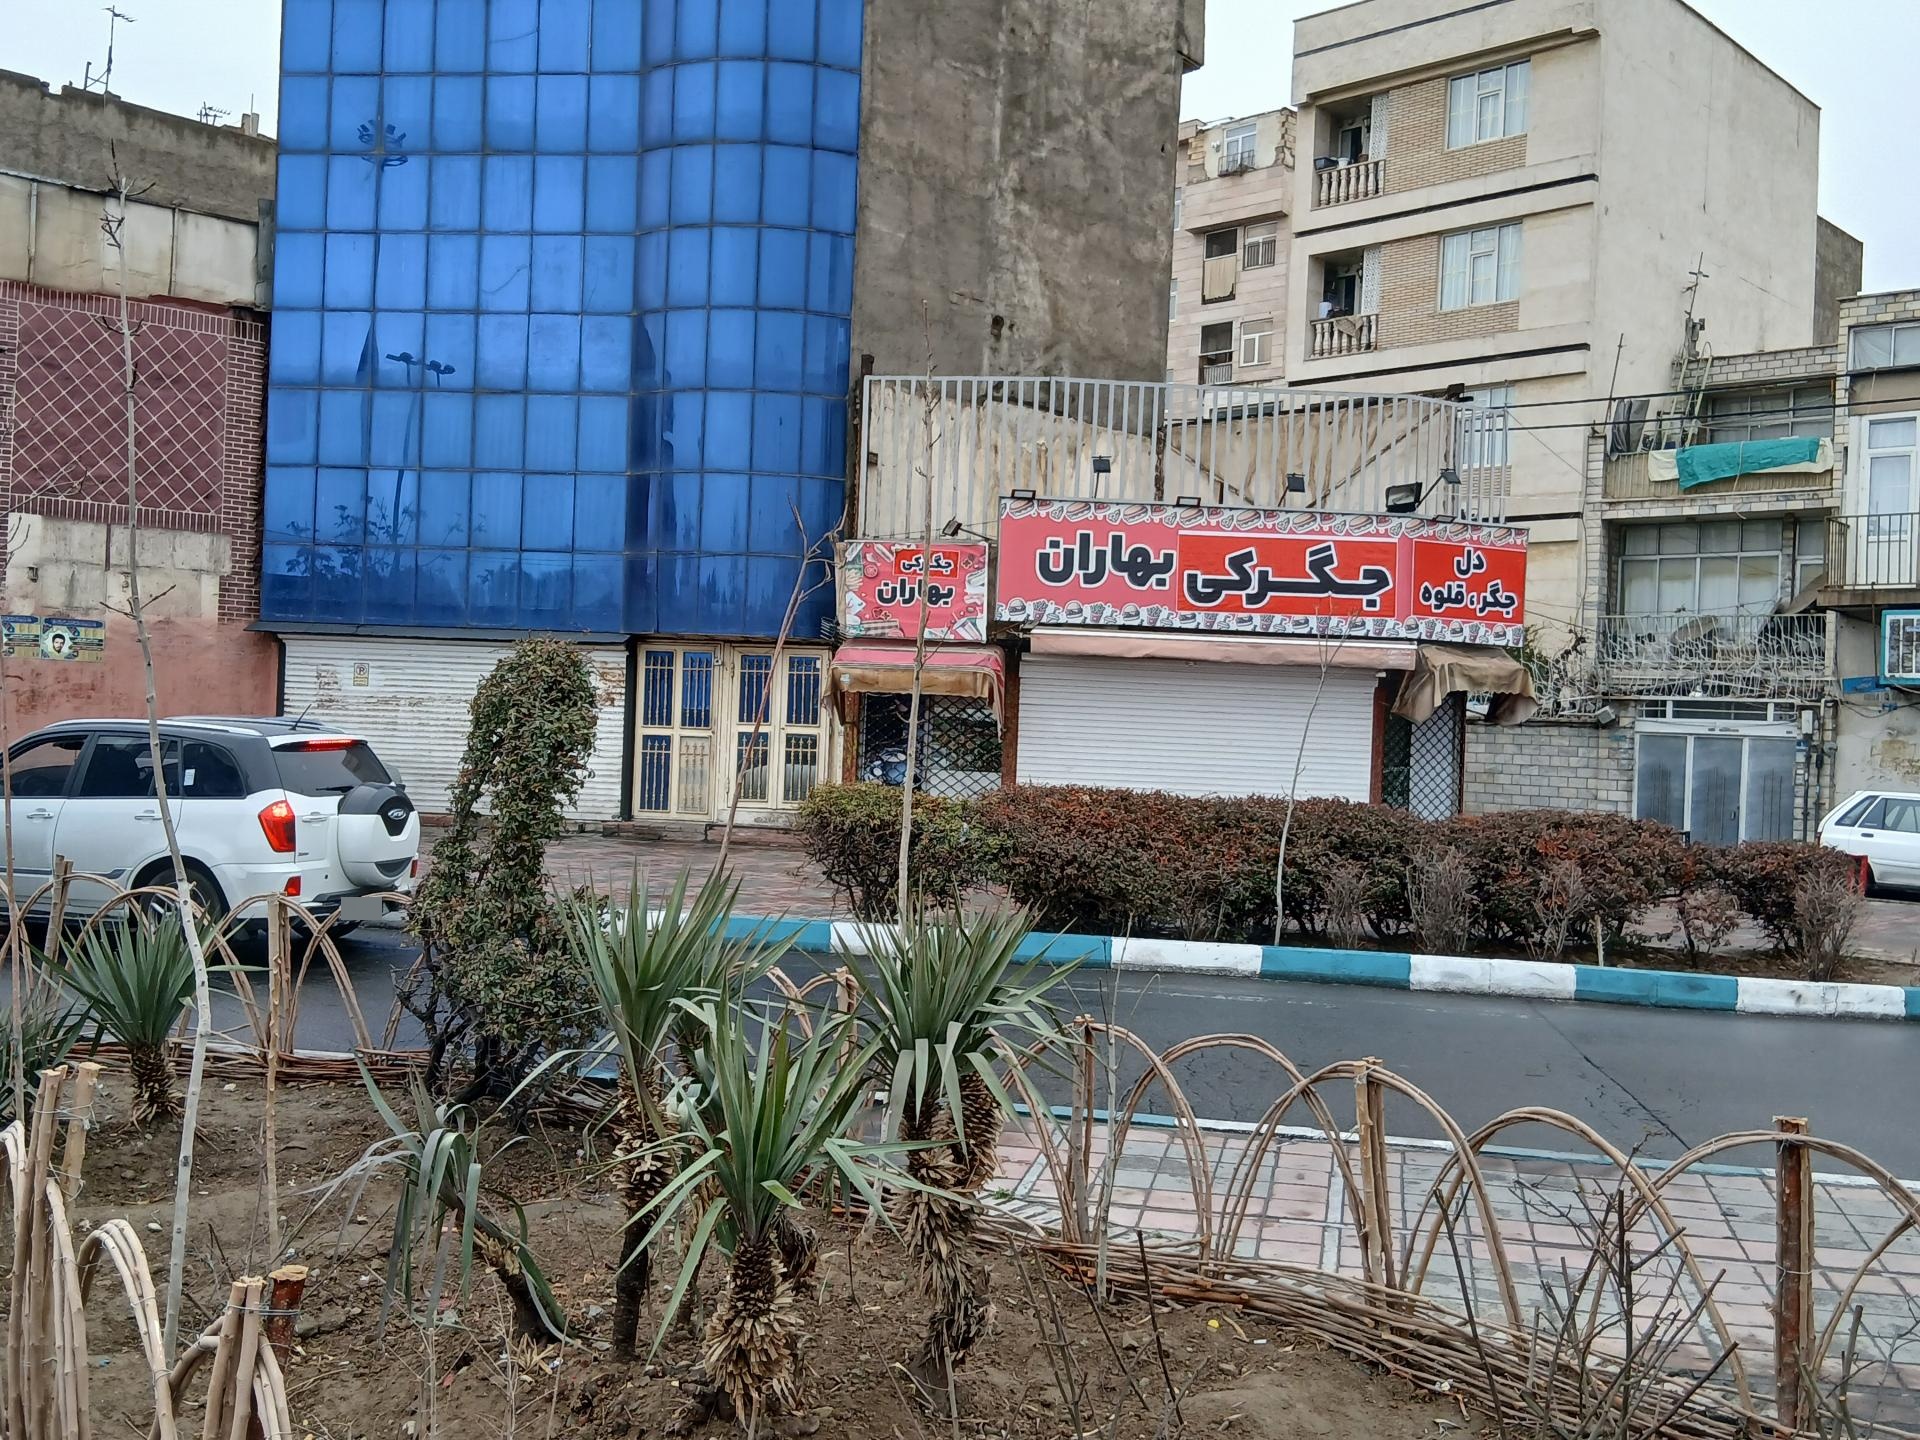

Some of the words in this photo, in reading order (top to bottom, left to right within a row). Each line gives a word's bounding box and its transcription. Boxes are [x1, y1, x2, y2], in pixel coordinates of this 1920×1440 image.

[1037, 531, 1176, 590] بهاران
[1455, 548, 1485, 577] دل
[1185, 543, 1391, 610] جگرکی
[877, 578, 955, 606] بهاران
[1421, 583, 1465, 611] قلوه
